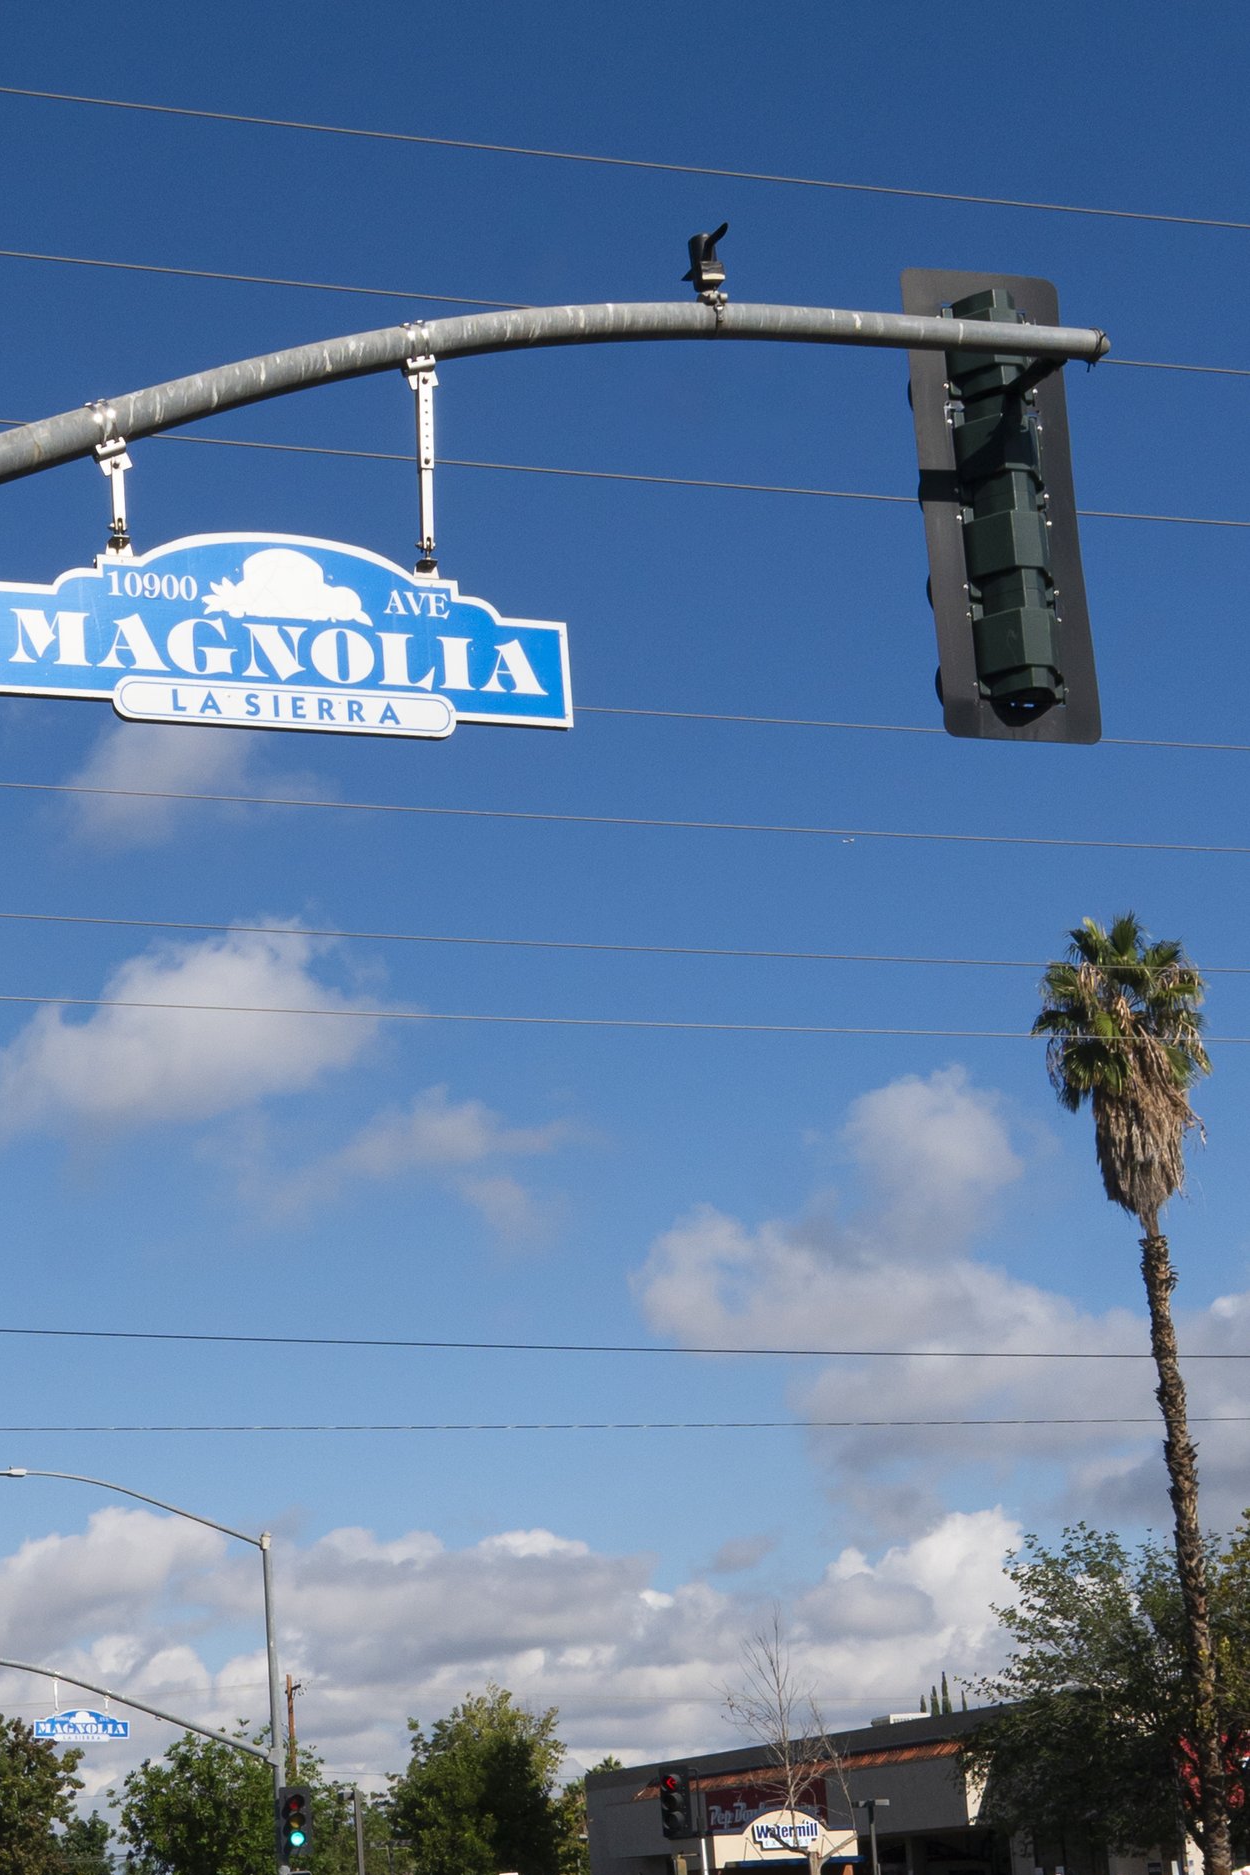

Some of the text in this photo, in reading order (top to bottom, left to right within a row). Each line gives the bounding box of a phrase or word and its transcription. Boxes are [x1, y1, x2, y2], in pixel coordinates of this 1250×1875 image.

[106, 570, 453, 621] 10900 AVE
[9, 607, 550, 697] MAGNOLIA
[171, 688, 402, 727] LA SIERRA
[38, 1723, 126, 1734] MAGNOLIA
[708, 1804, 734, 1830] Pep
